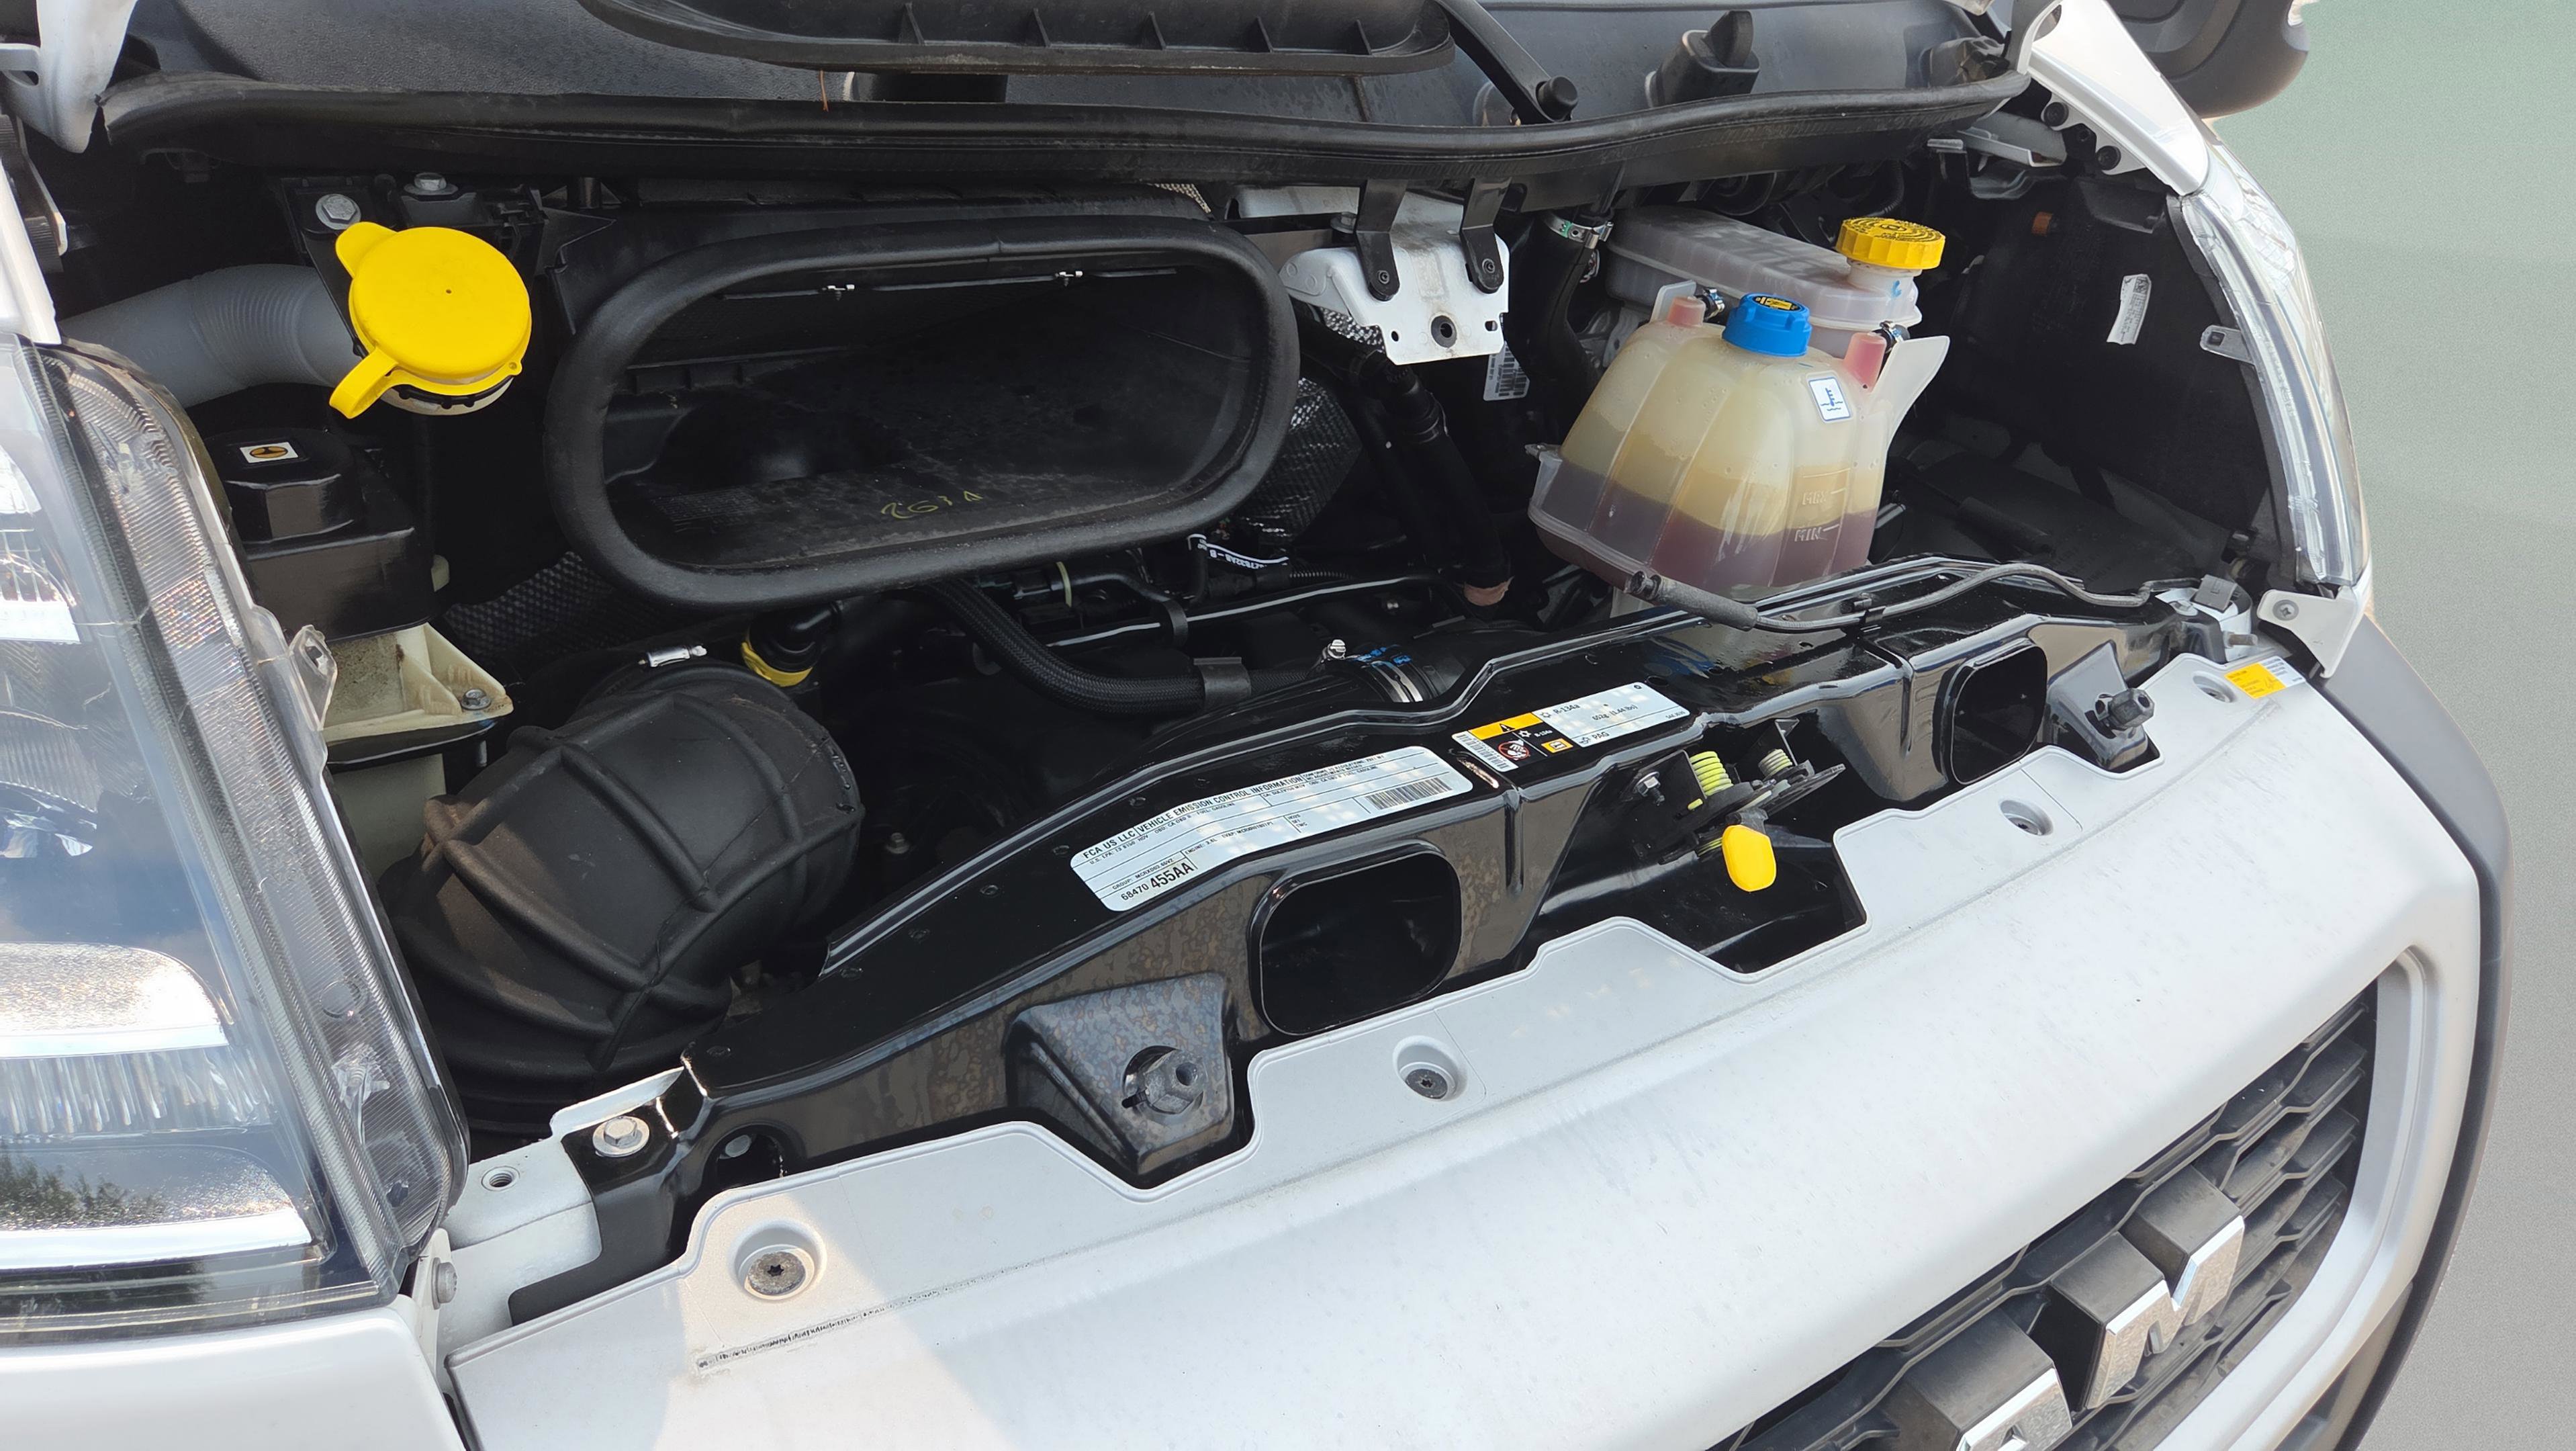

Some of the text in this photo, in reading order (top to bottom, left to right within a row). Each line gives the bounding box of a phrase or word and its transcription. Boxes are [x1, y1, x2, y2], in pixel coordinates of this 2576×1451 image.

[1794, 527, 1822, 542] MIN
[1553, 703, 1580, 715] R-134a
[1592, 731, 1610, 740] PAG
[1137, 776, 1303, 832] VEHICLE EMISSION CONTROL INFORMATION
[1083, 830, 1136, 859] FCA US LLC
[1185, 843, 1205, 854] ENGINE:
[1112, 879, 1133, 890] GROUP:
[1121, 862, 1194, 901] 68470 455AA
